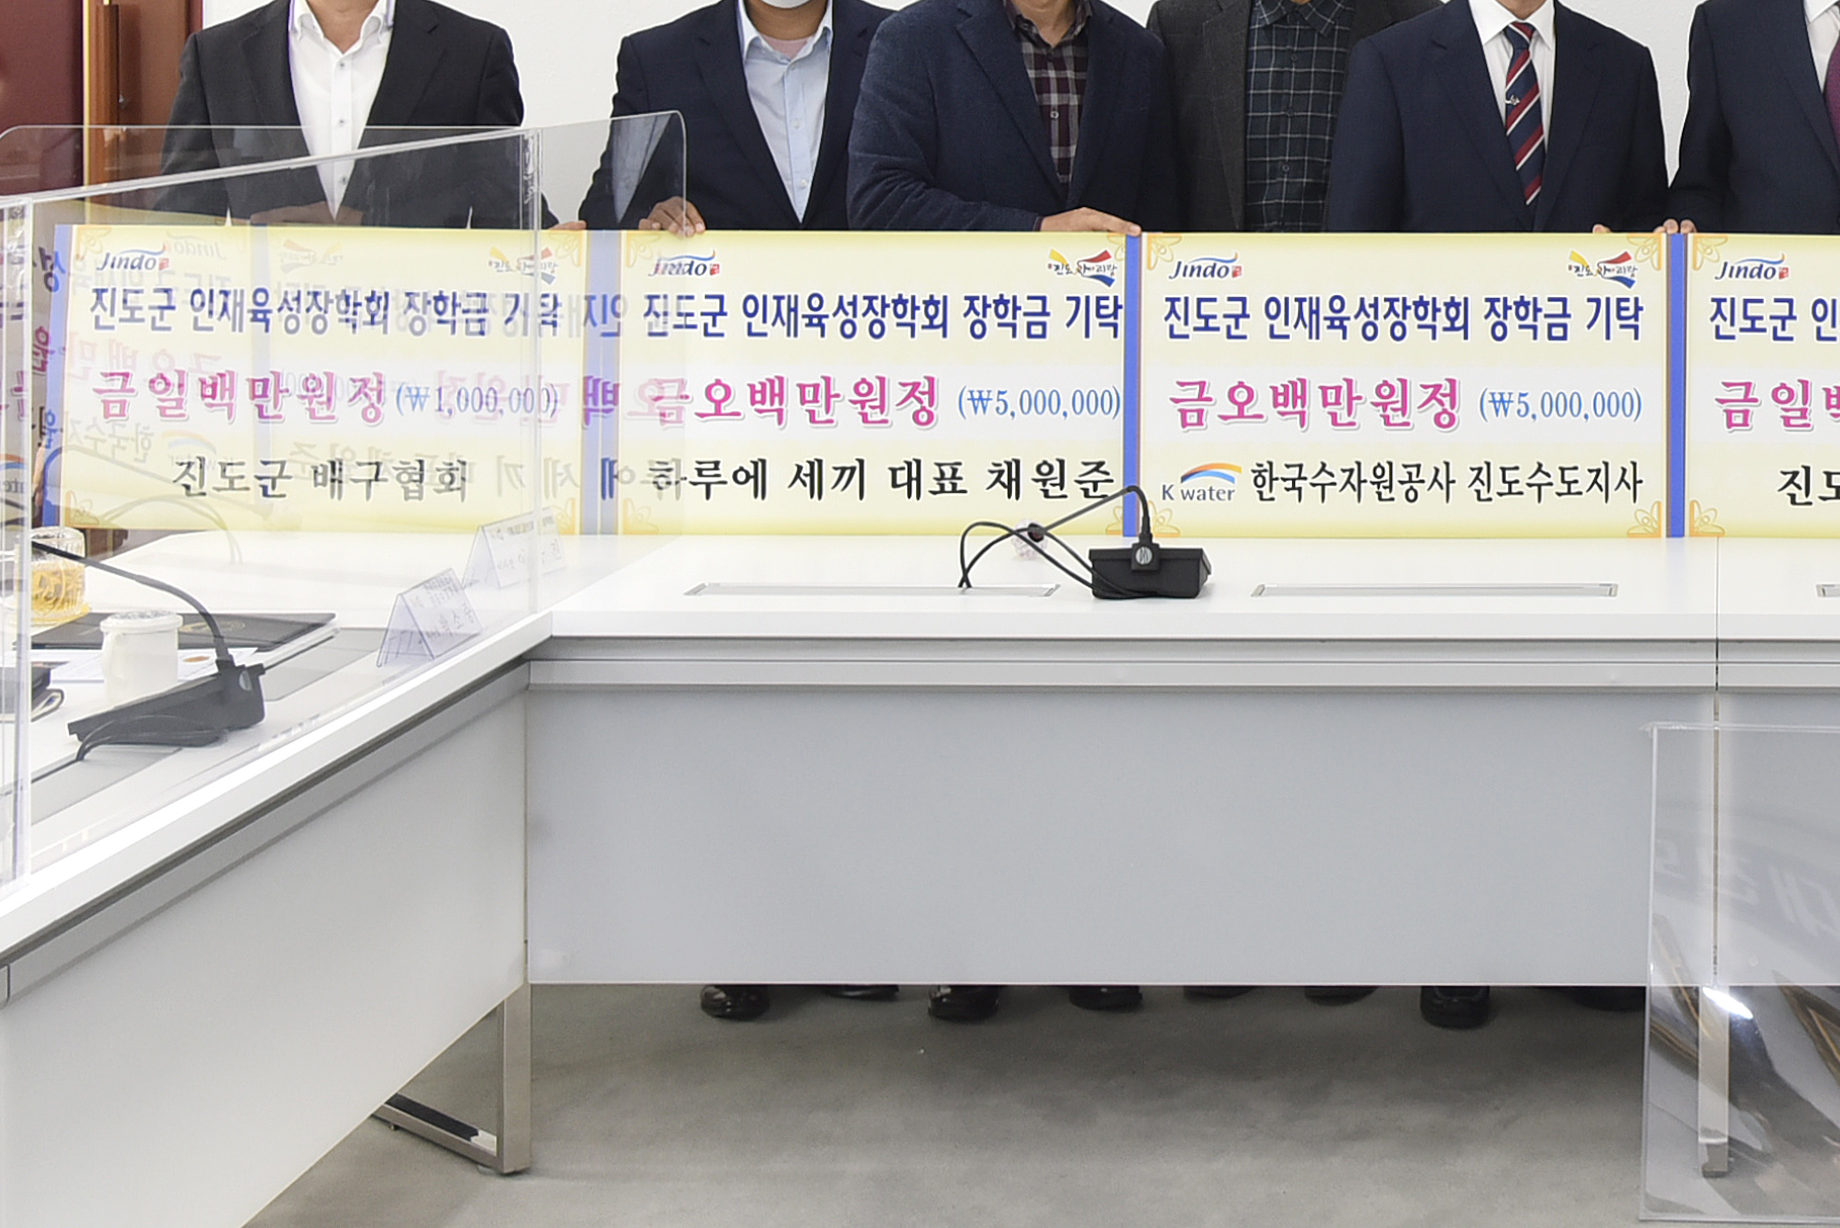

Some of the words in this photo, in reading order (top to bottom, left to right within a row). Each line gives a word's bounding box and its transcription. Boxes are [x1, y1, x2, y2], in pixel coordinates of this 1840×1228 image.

[97, 252, 157, 271] Jindo
[1169, 259, 1230, 279] Jindo
[1715, 260, 1776, 280] Jindo
[90, 287, 175, 332] 진도군
[190, 288, 390, 337] 인재육성장학회
[403, 291, 489, 336] 장학금
[643, 294, 728, 338] 진도군
[742, 293, 948, 339] 인재육성장학회
[963, 294, 1051, 339] 장학금
[1065, 294, 1122, 340] 기탁
[1164, 296, 1250, 340] 진도군
[1265, 295, 1468, 342] 인재육성장학회
[1484, 295, 1571, 341] 장학금
[1587, 297, 1644, 340] 기탁
[1710, 297, 1797, 341] 진도군
[93, 370, 386, 424] 금일백만원정
[396, 382, 559, 418] (₩1,000,000)
[652, 375, 937, 427] 금오백만원정
[958, 388, 1121, 420] (₩5,000,000)
[1170, 378, 1456, 429] 금오백만원정
[1479, 389, 1642, 421] (₩5,000,000)
[172, 457, 292, 498] 진도군
[312, 457, 468, 502] 배구협회
[650, 458, 768, 500] 하루에
[788, 458, 864, 501] 세끼
[888, 458, 968, 501] 대표
[985, 458, 1114, 499] 채원준
[1162, 484, 1174, 501] K
[1180, 485, 1235, 501] water
[1251, 460, 1456, 503] 한국수자원공사
[1468, 461, 1643, 504] 진도수도지사
